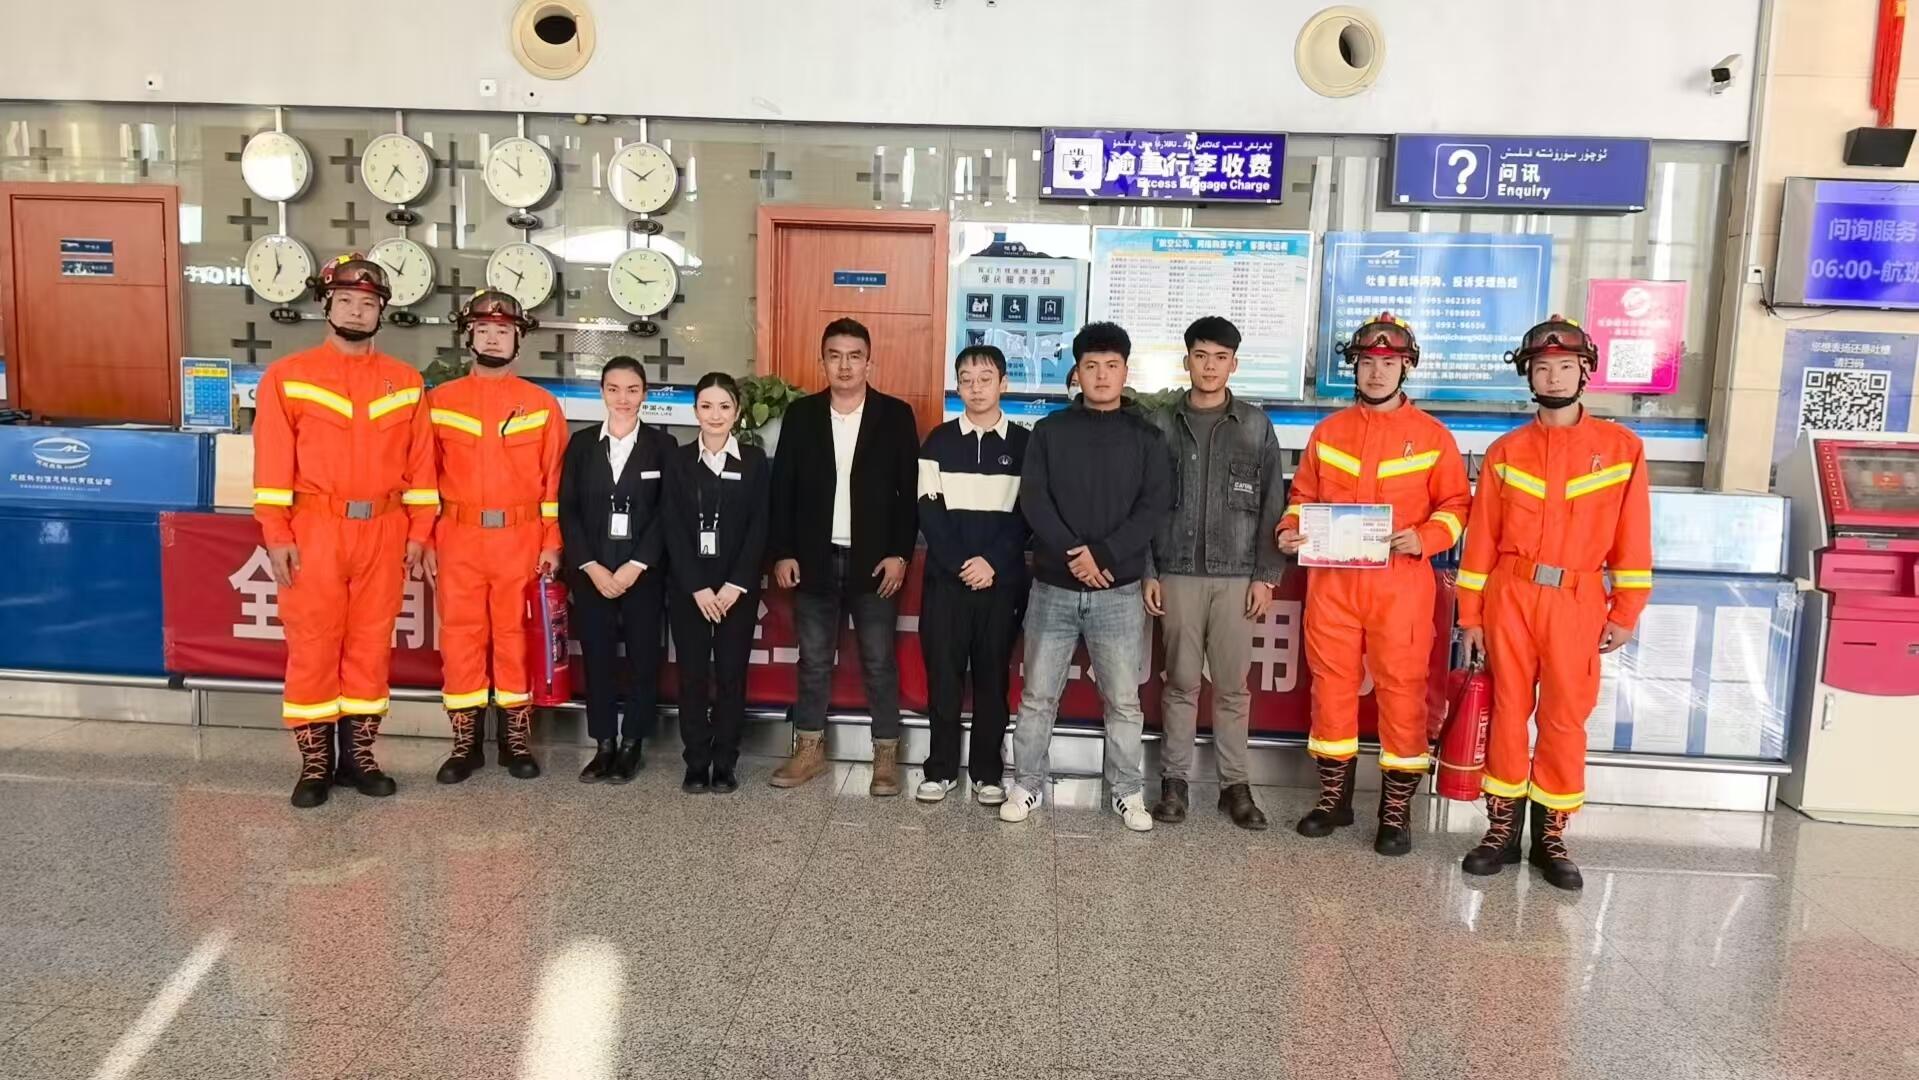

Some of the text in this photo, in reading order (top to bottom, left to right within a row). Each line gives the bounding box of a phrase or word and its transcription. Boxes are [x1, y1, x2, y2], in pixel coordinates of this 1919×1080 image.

[1499, 163, 1541, 183] 问讯
[1230, 180, 1270, 193] Charge
[1498, 184, 1551, 199] Enquiry
[1828, 217, 1917, 243] 问询服务
[1811, 259, 1919, 284] 06:00-航班
[981, 274, 1051, 285] 便民服务项目
[642, 404, 673, 412] 中国人寿
